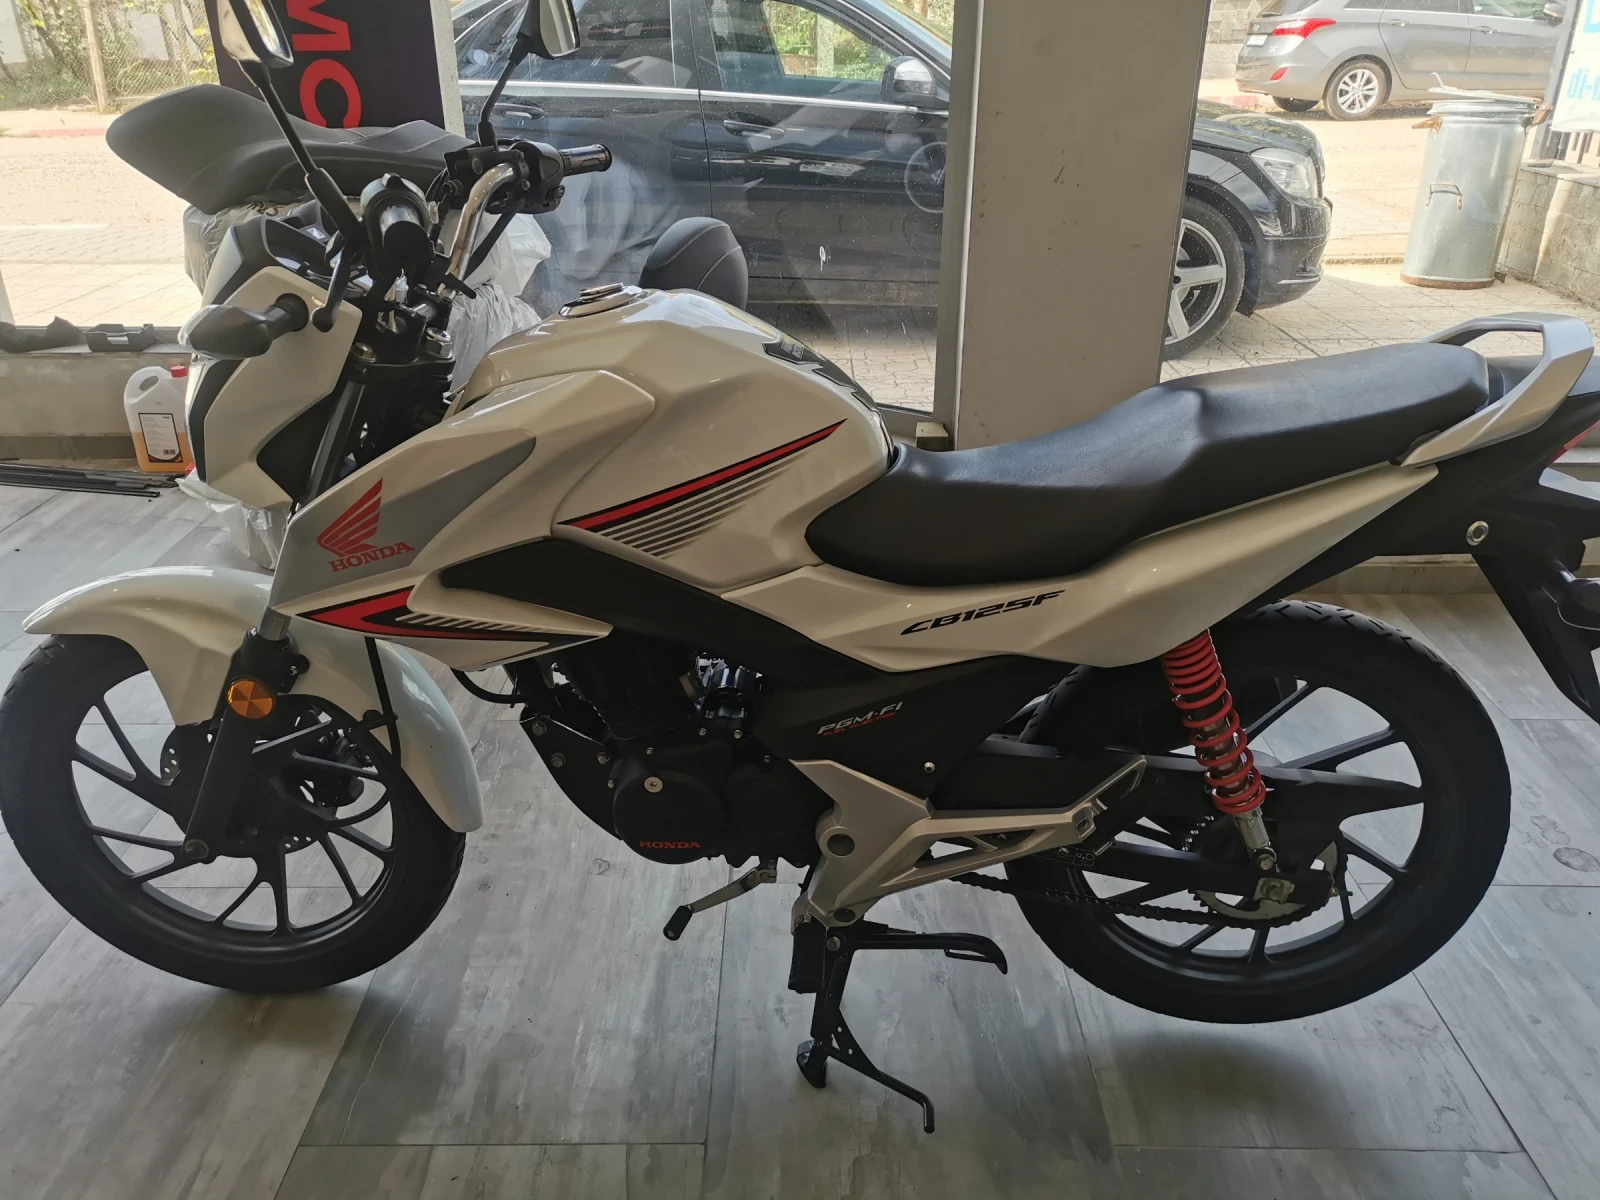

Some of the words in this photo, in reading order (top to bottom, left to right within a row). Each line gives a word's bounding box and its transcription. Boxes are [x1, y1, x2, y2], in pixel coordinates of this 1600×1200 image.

[328, 541, 414, 572] HONDA
[900, 589, 1066, 636] CB125F
[639, 840, 703, 849] HONDA
